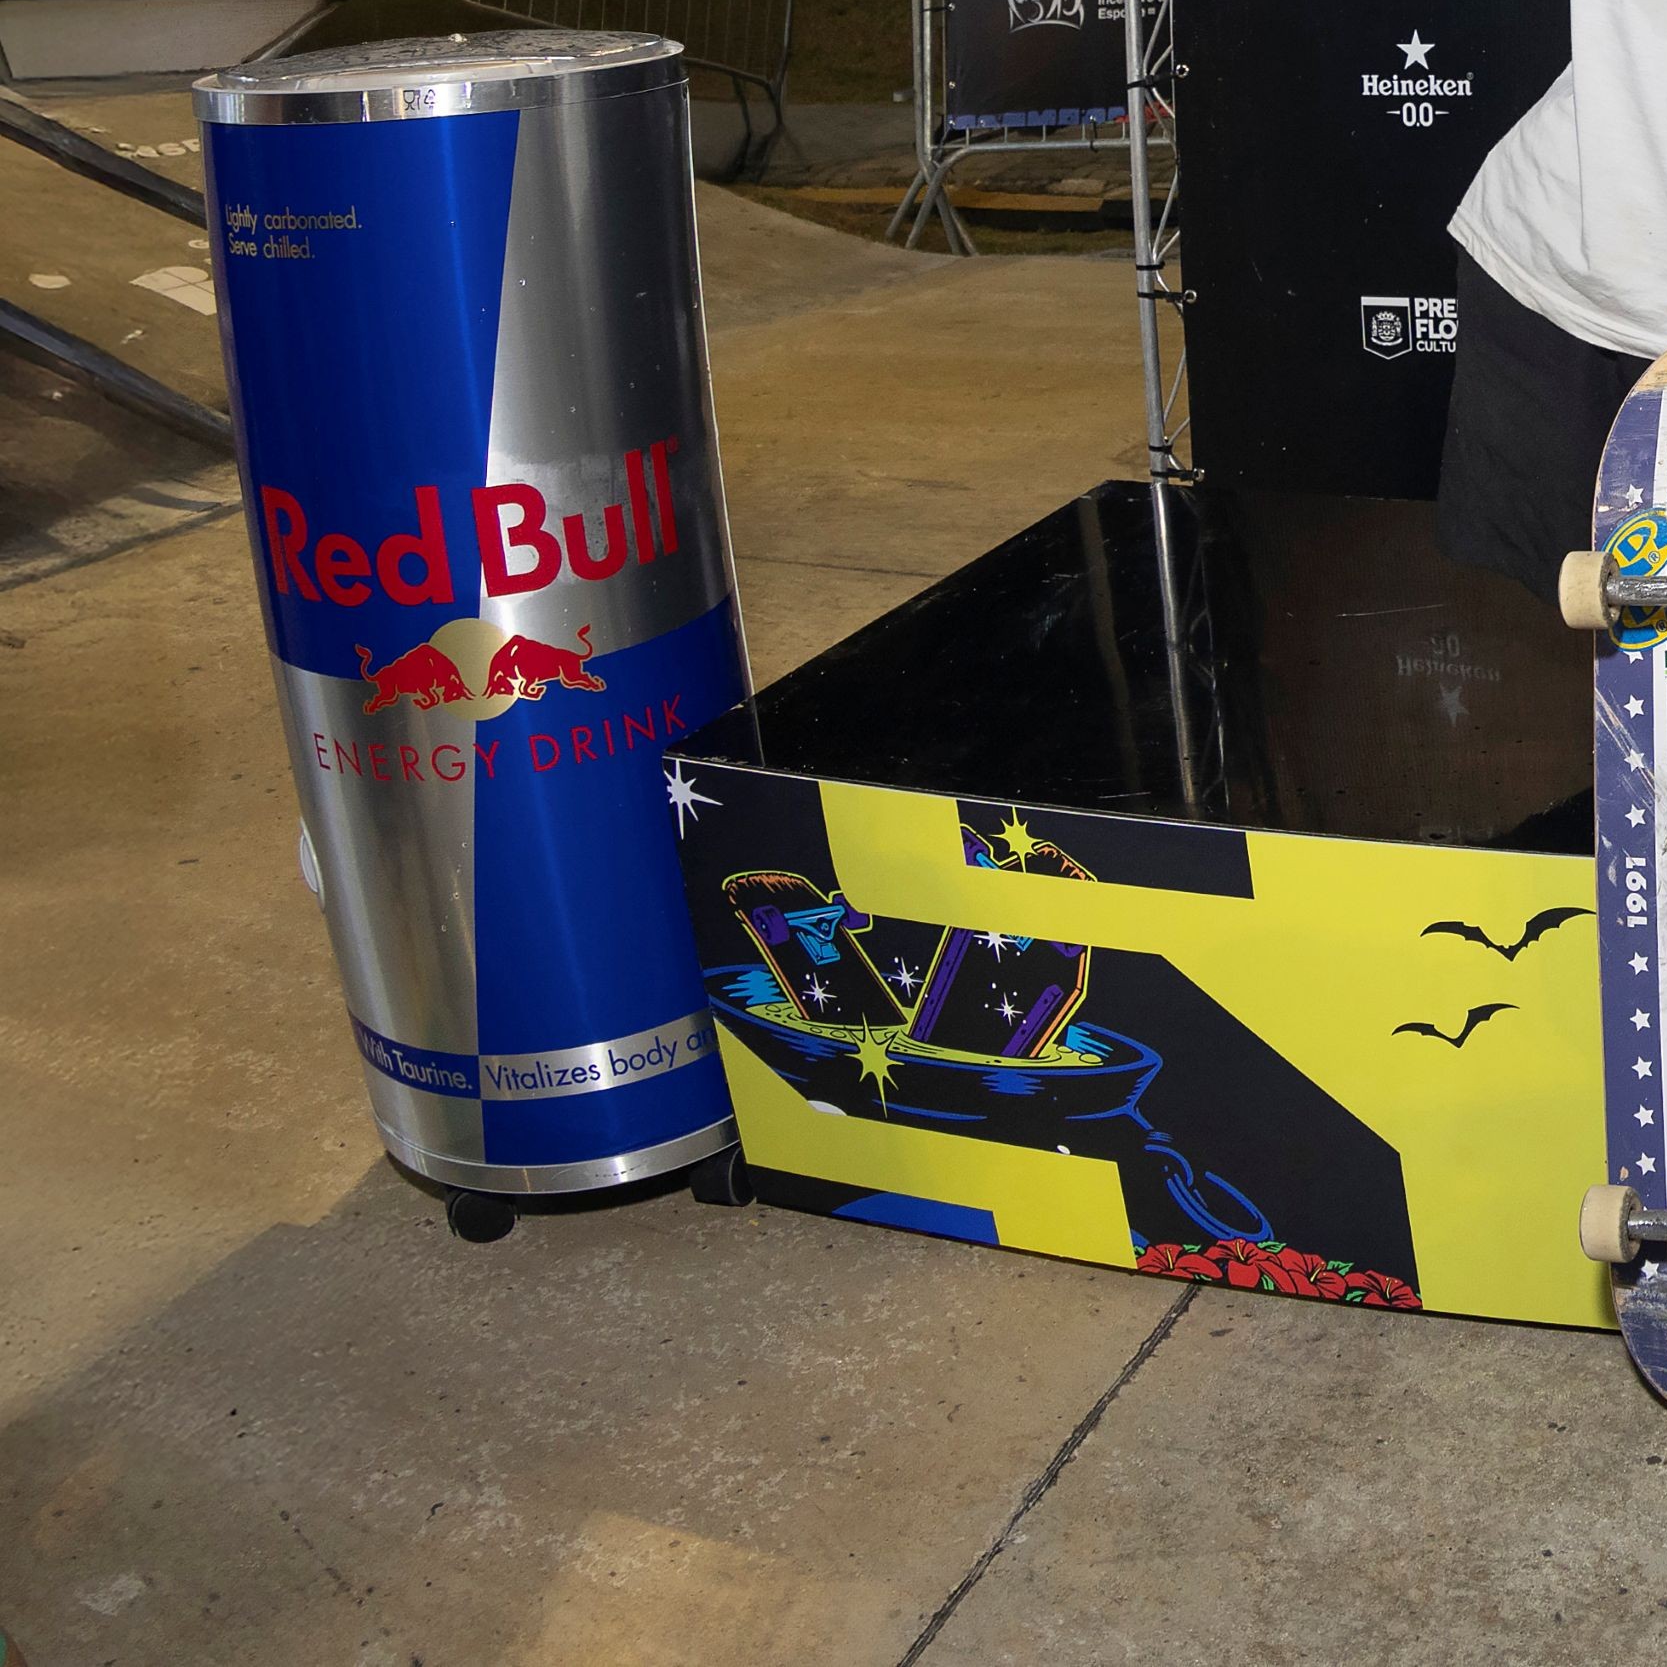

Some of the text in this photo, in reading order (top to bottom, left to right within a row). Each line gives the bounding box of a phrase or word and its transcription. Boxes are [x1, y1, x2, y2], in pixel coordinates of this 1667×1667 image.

[1362, 73, 1472, 98] Heineken
[1402, 102, 1434, 128] 0.0
[225, 203, 362, 235] Lightly carbonated.
[228, 235, 316, 260] Serve chilled.
[261, 440, 678, 606] Red Bull
[313, 694, 688, 783] ENERGY DRINK
[1625, 855, 1650, 929] 1991
[359, 1030, 473, 1091] With Taurine.
[484, 1061, 601, 1094] Vitalizes
[607, 1037, 678, 1077] body
